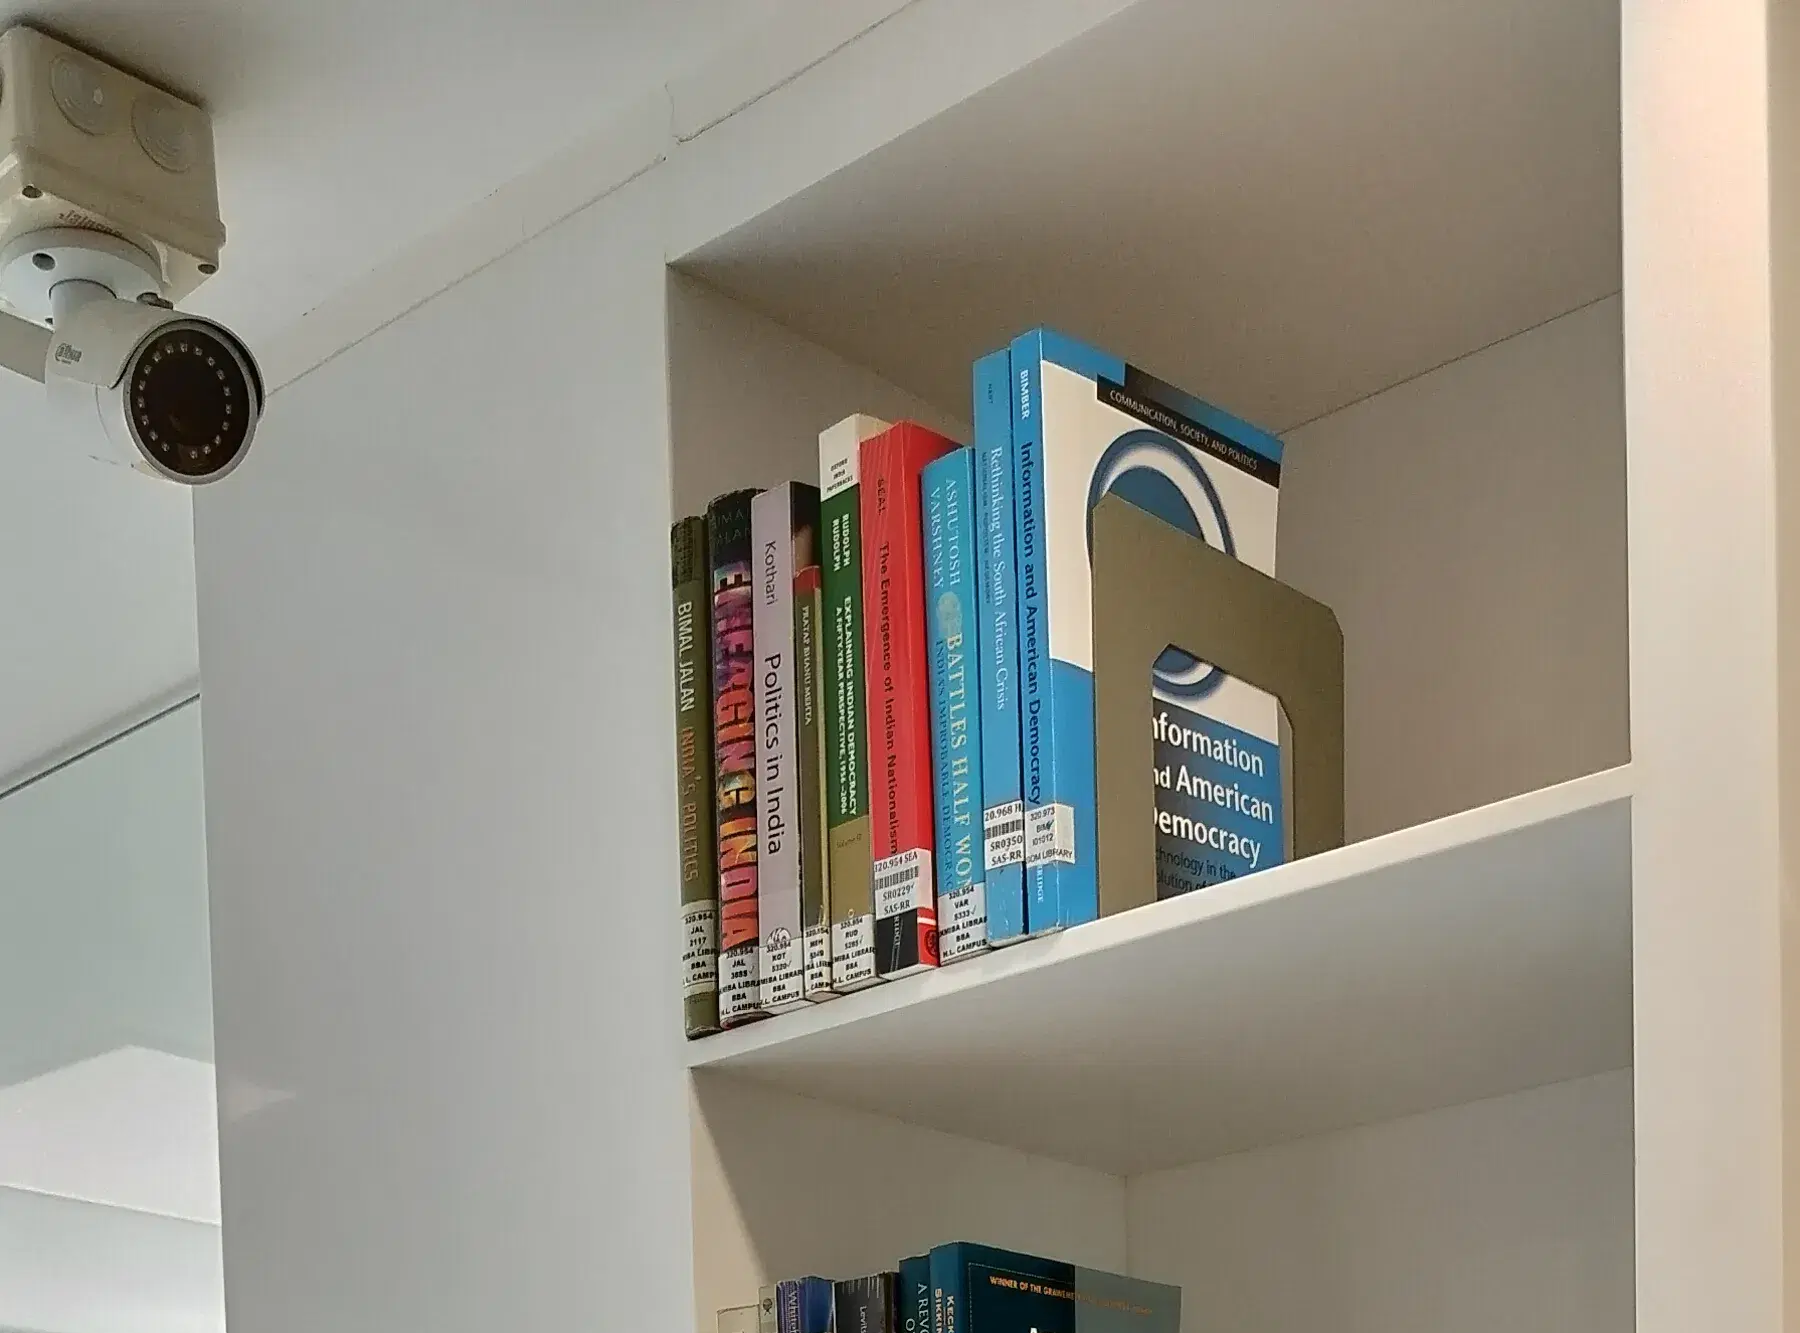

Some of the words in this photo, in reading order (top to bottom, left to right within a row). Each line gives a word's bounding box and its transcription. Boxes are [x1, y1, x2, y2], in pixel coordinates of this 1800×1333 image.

[1021, 368, 1032, 421] BIMBER
[989, 446, 1006, 533] Rethinking
[1021, 441, 1037, 558] Information
[879, 543, 890, 575] The
[930, 486, 944, 590] VARSHNEY
[946, 479, 962, 586] ASHUTOSH
[993, 533, 1007, 557] the
[762, 539, 780, 607] Kothari
[994, 560, 1008, 607] South
[1025, 563, 1038, 605] and
[678, 602, 696, 656] BIMAL
[844, 595, 855, 677] EXPLAINING
[879, 578, 894, 674] Emergence
[996, 611, 1008, 664] African
[1026, 605, 1041, 695] American
[680, 660, 695, 712] JALAN
[713, 558, 755, 812] EMERGING
[762, 653, 784, 744] Politics
[846, 680, 856, 730] INDIAN
[884, 677, 894, 694] of
[997, 667, 1009, 711] Crisis
[885, 697, 897, 751] Indian
[1028, 699, 1044, 805] Democracy
[766, 752, 784, 780] in
[847, 732, 857, 816] DEMOCRACY
[1176, 765, 1273, 825] American
[765, 786, 786, 855] India
[887, 754, 900, 856] Nationalism
[717, 816, 759, 950] INDIA
[918, 1282, 928, 1295] A
